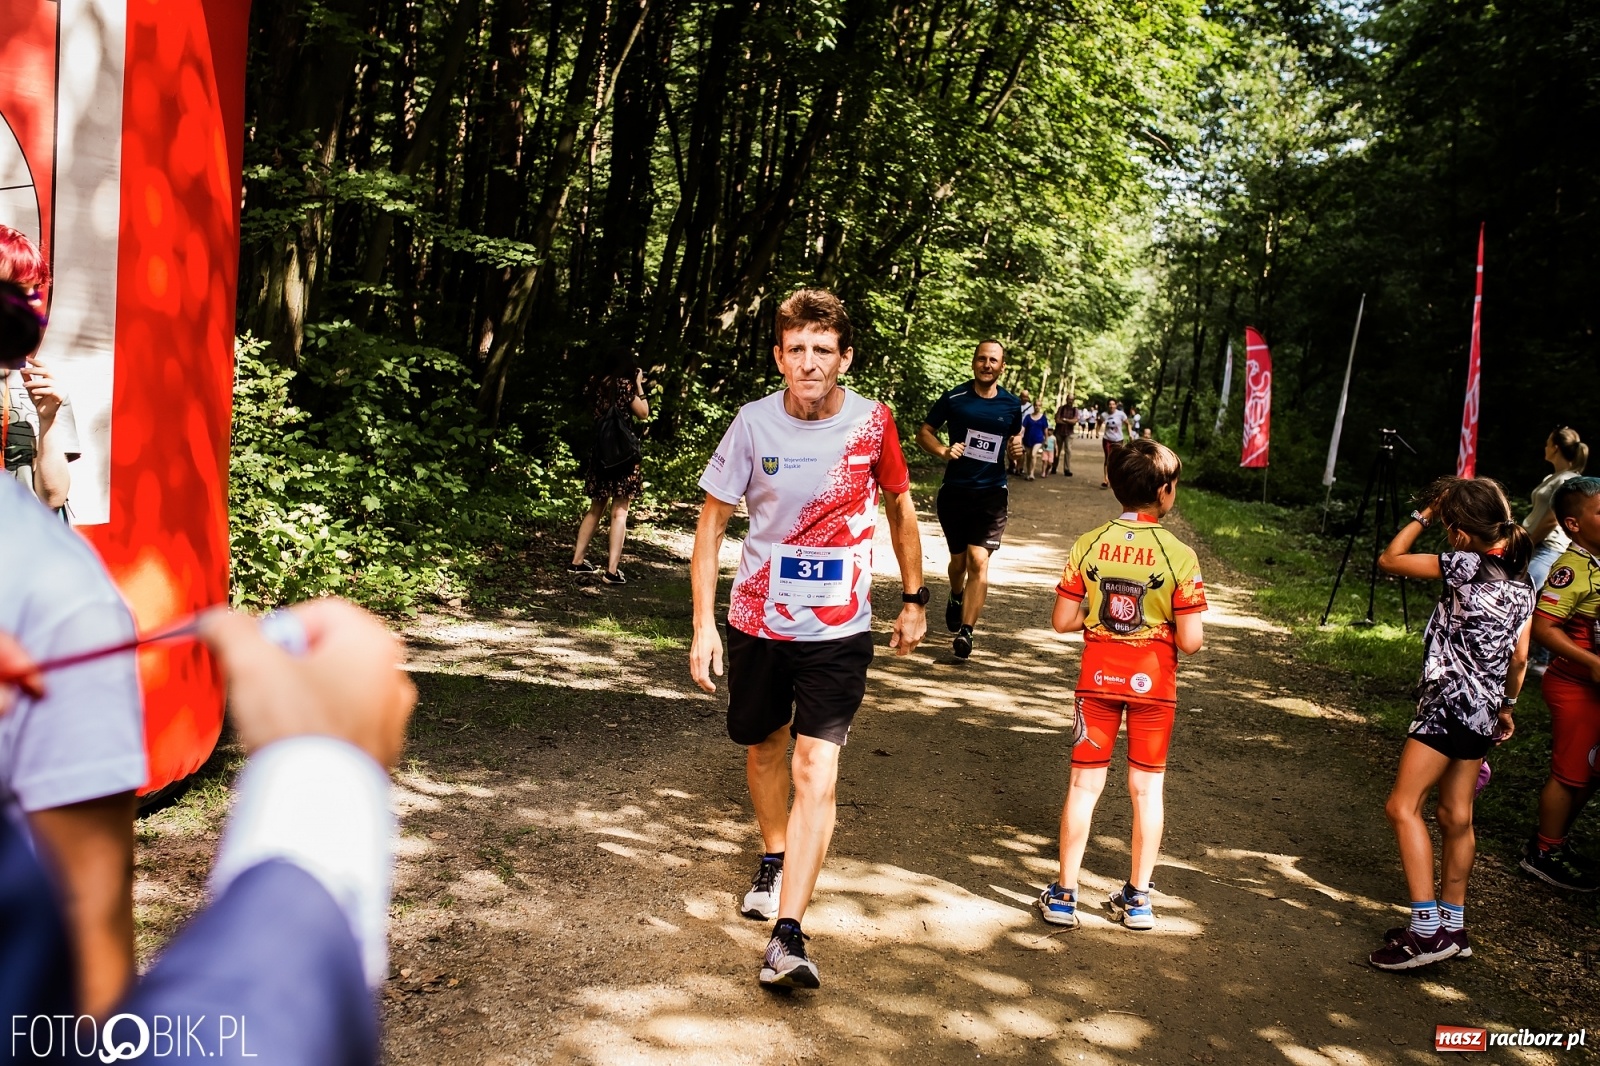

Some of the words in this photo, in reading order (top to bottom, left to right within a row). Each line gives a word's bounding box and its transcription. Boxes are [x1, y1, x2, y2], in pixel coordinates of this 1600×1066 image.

[976, 440, 990, 450] 30
[1098, 543, 1156, 566] RAFAŁ
[797, 560, 824, 578] 31
[1418, 910, 1431, 920] 6
[1441, 909, 1451, 920] 6
